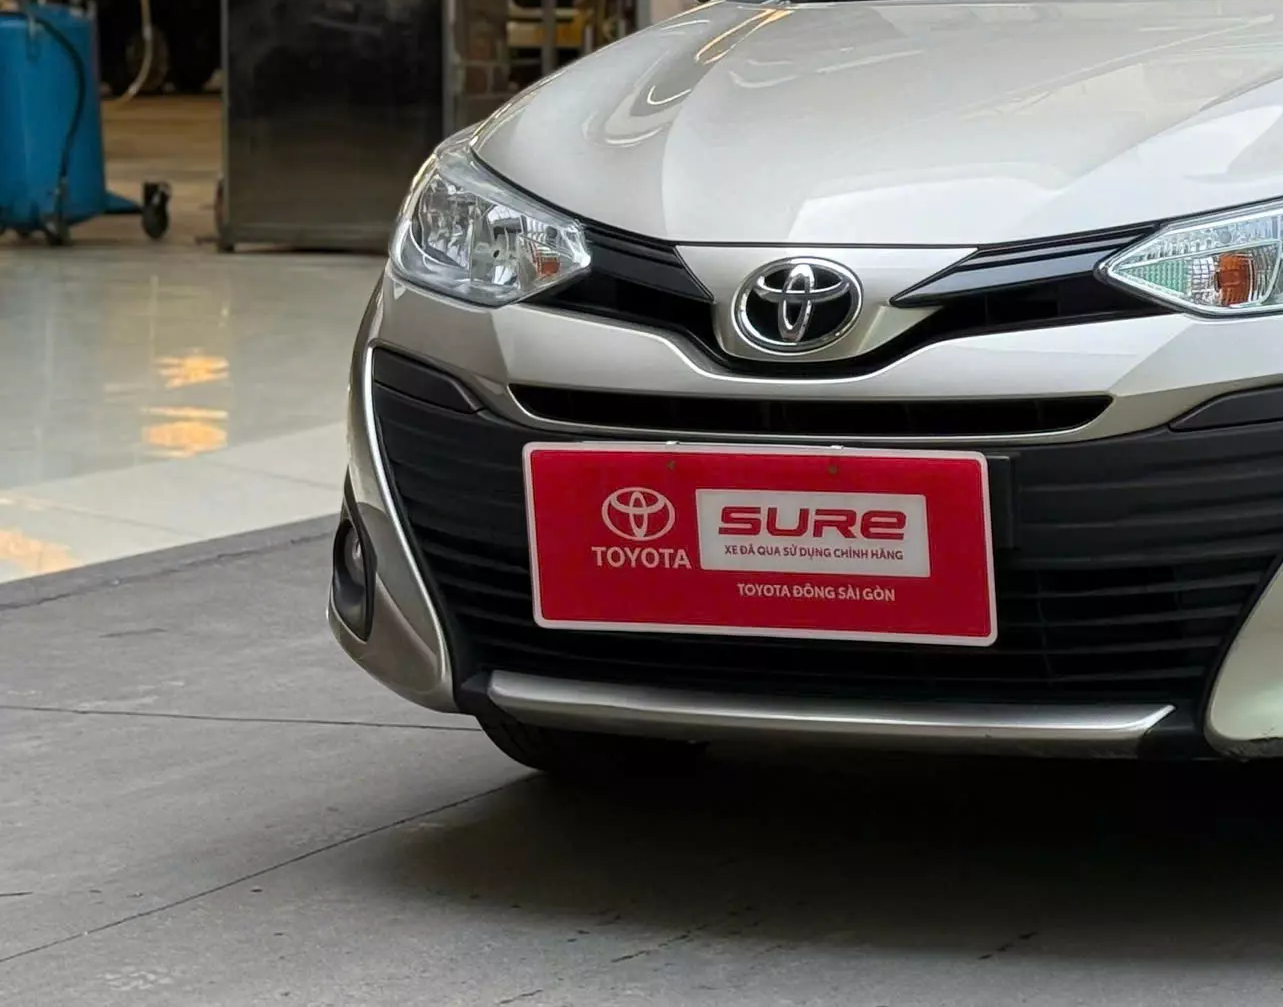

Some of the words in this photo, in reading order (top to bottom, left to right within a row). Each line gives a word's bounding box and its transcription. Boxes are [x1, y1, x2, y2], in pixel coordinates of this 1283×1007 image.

[591, 546, 692, 570] TOYOTA
[724, 545, 740, 555] XE
[757, 545, 781, 557] QUA
[799, 547, 831, 560] DỤNG
[834, 546, 869, 559] CHÍNH
[737, 583, 791, 598] TOYOTA
[793, 583, 835, 599] ĐÔNG
[838, 584, 860, 600] SÀI
[863, 585, 896, 601] GÒN
